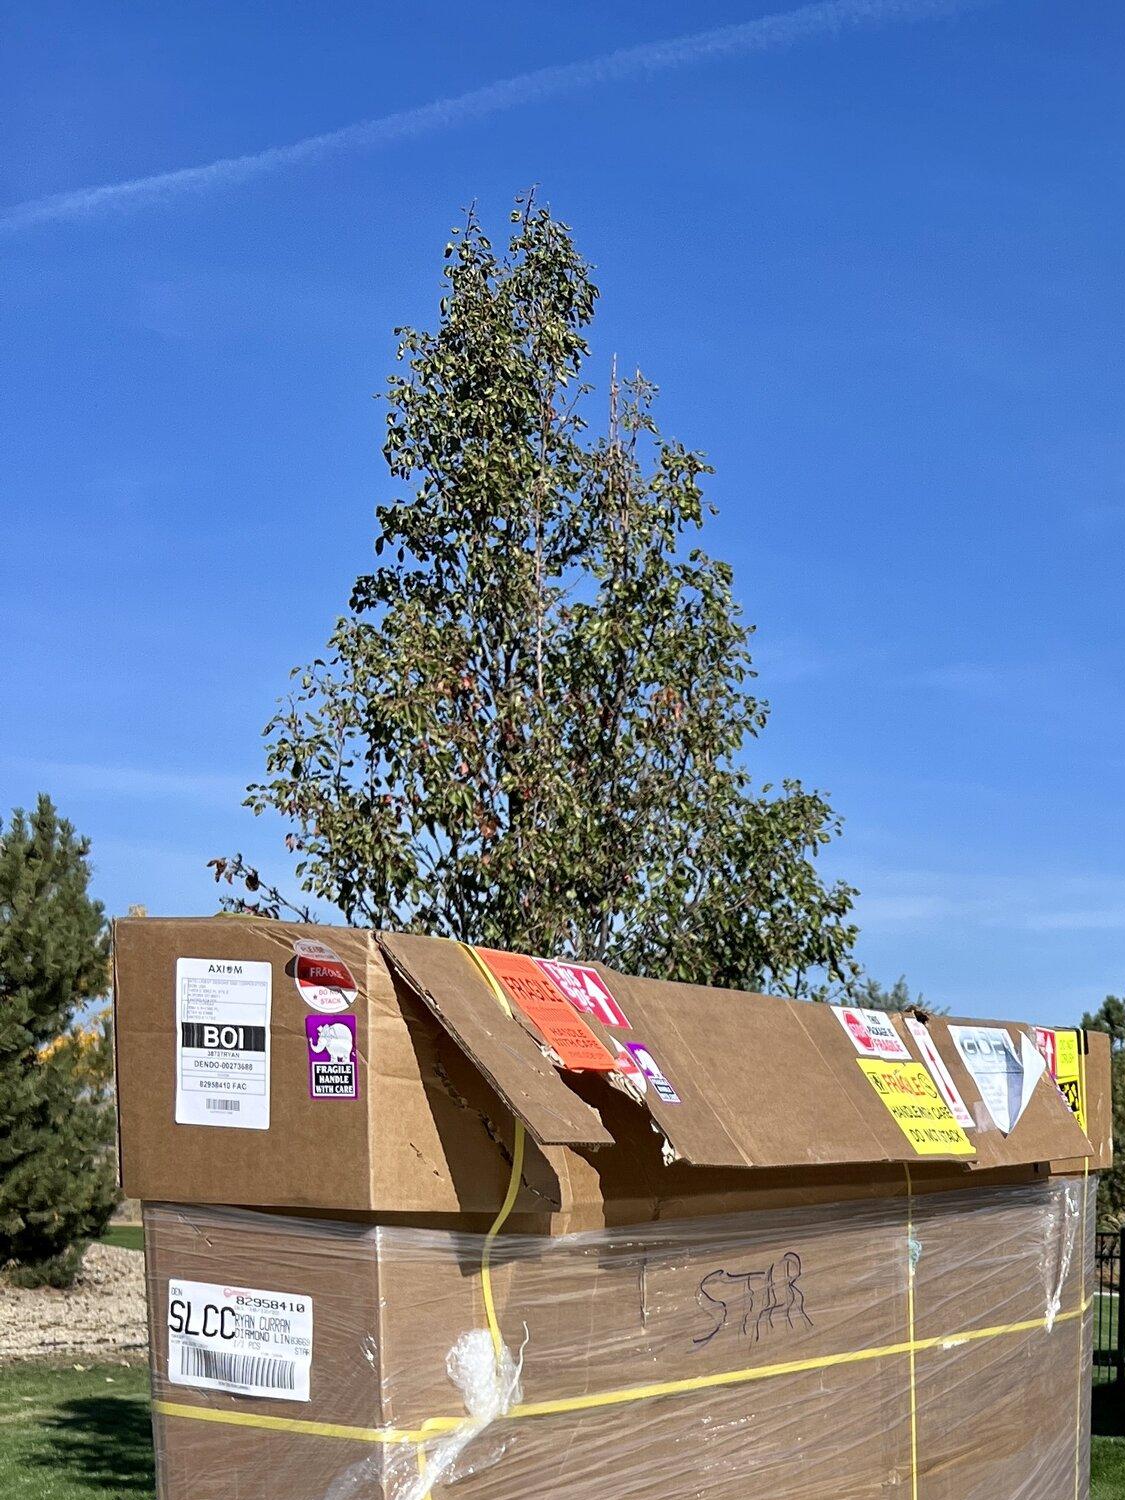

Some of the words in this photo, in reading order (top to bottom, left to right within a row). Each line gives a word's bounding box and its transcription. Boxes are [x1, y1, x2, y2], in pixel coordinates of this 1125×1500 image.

[502, 976, 564, 1003] FRAGILE
[203, 1025, 245, 1050] BOI
[549, 1027, 587, 1039] HANDLE
[316, 1065, 352, 1075] FRAGILE
[199, 1080, 231, 1091] 82958410
[232, 1082, 248, 1091] FAC
[319, 1075, 350, 1085] HANDLE
[881, 1072, 927, 1097] FRAGILE
[315, 1085, 335, 1094] WITH
[335, 1085, 354, 1095] CARE
[890, 1105, 922, 1119] HANDLE
[930, 1106, 954, 1120] CARE
[909, 1128, 926, 1143] DO
[923, 1128, 941, 1142] NOT
[938, 1129, 965, 1144] STACK
[236, 1295, 306, 1314] 82958410
[692, 1251, 815, 1345] STAR
[169, 1299, 236, 1340] SLCC
[234, 1313, 255, 1329] RYAN
[259, 1316, 291, 1334] CURRAN
[248, 1341, 261, 1351] PCS
[274, 1333, 290, 1345] LIN
